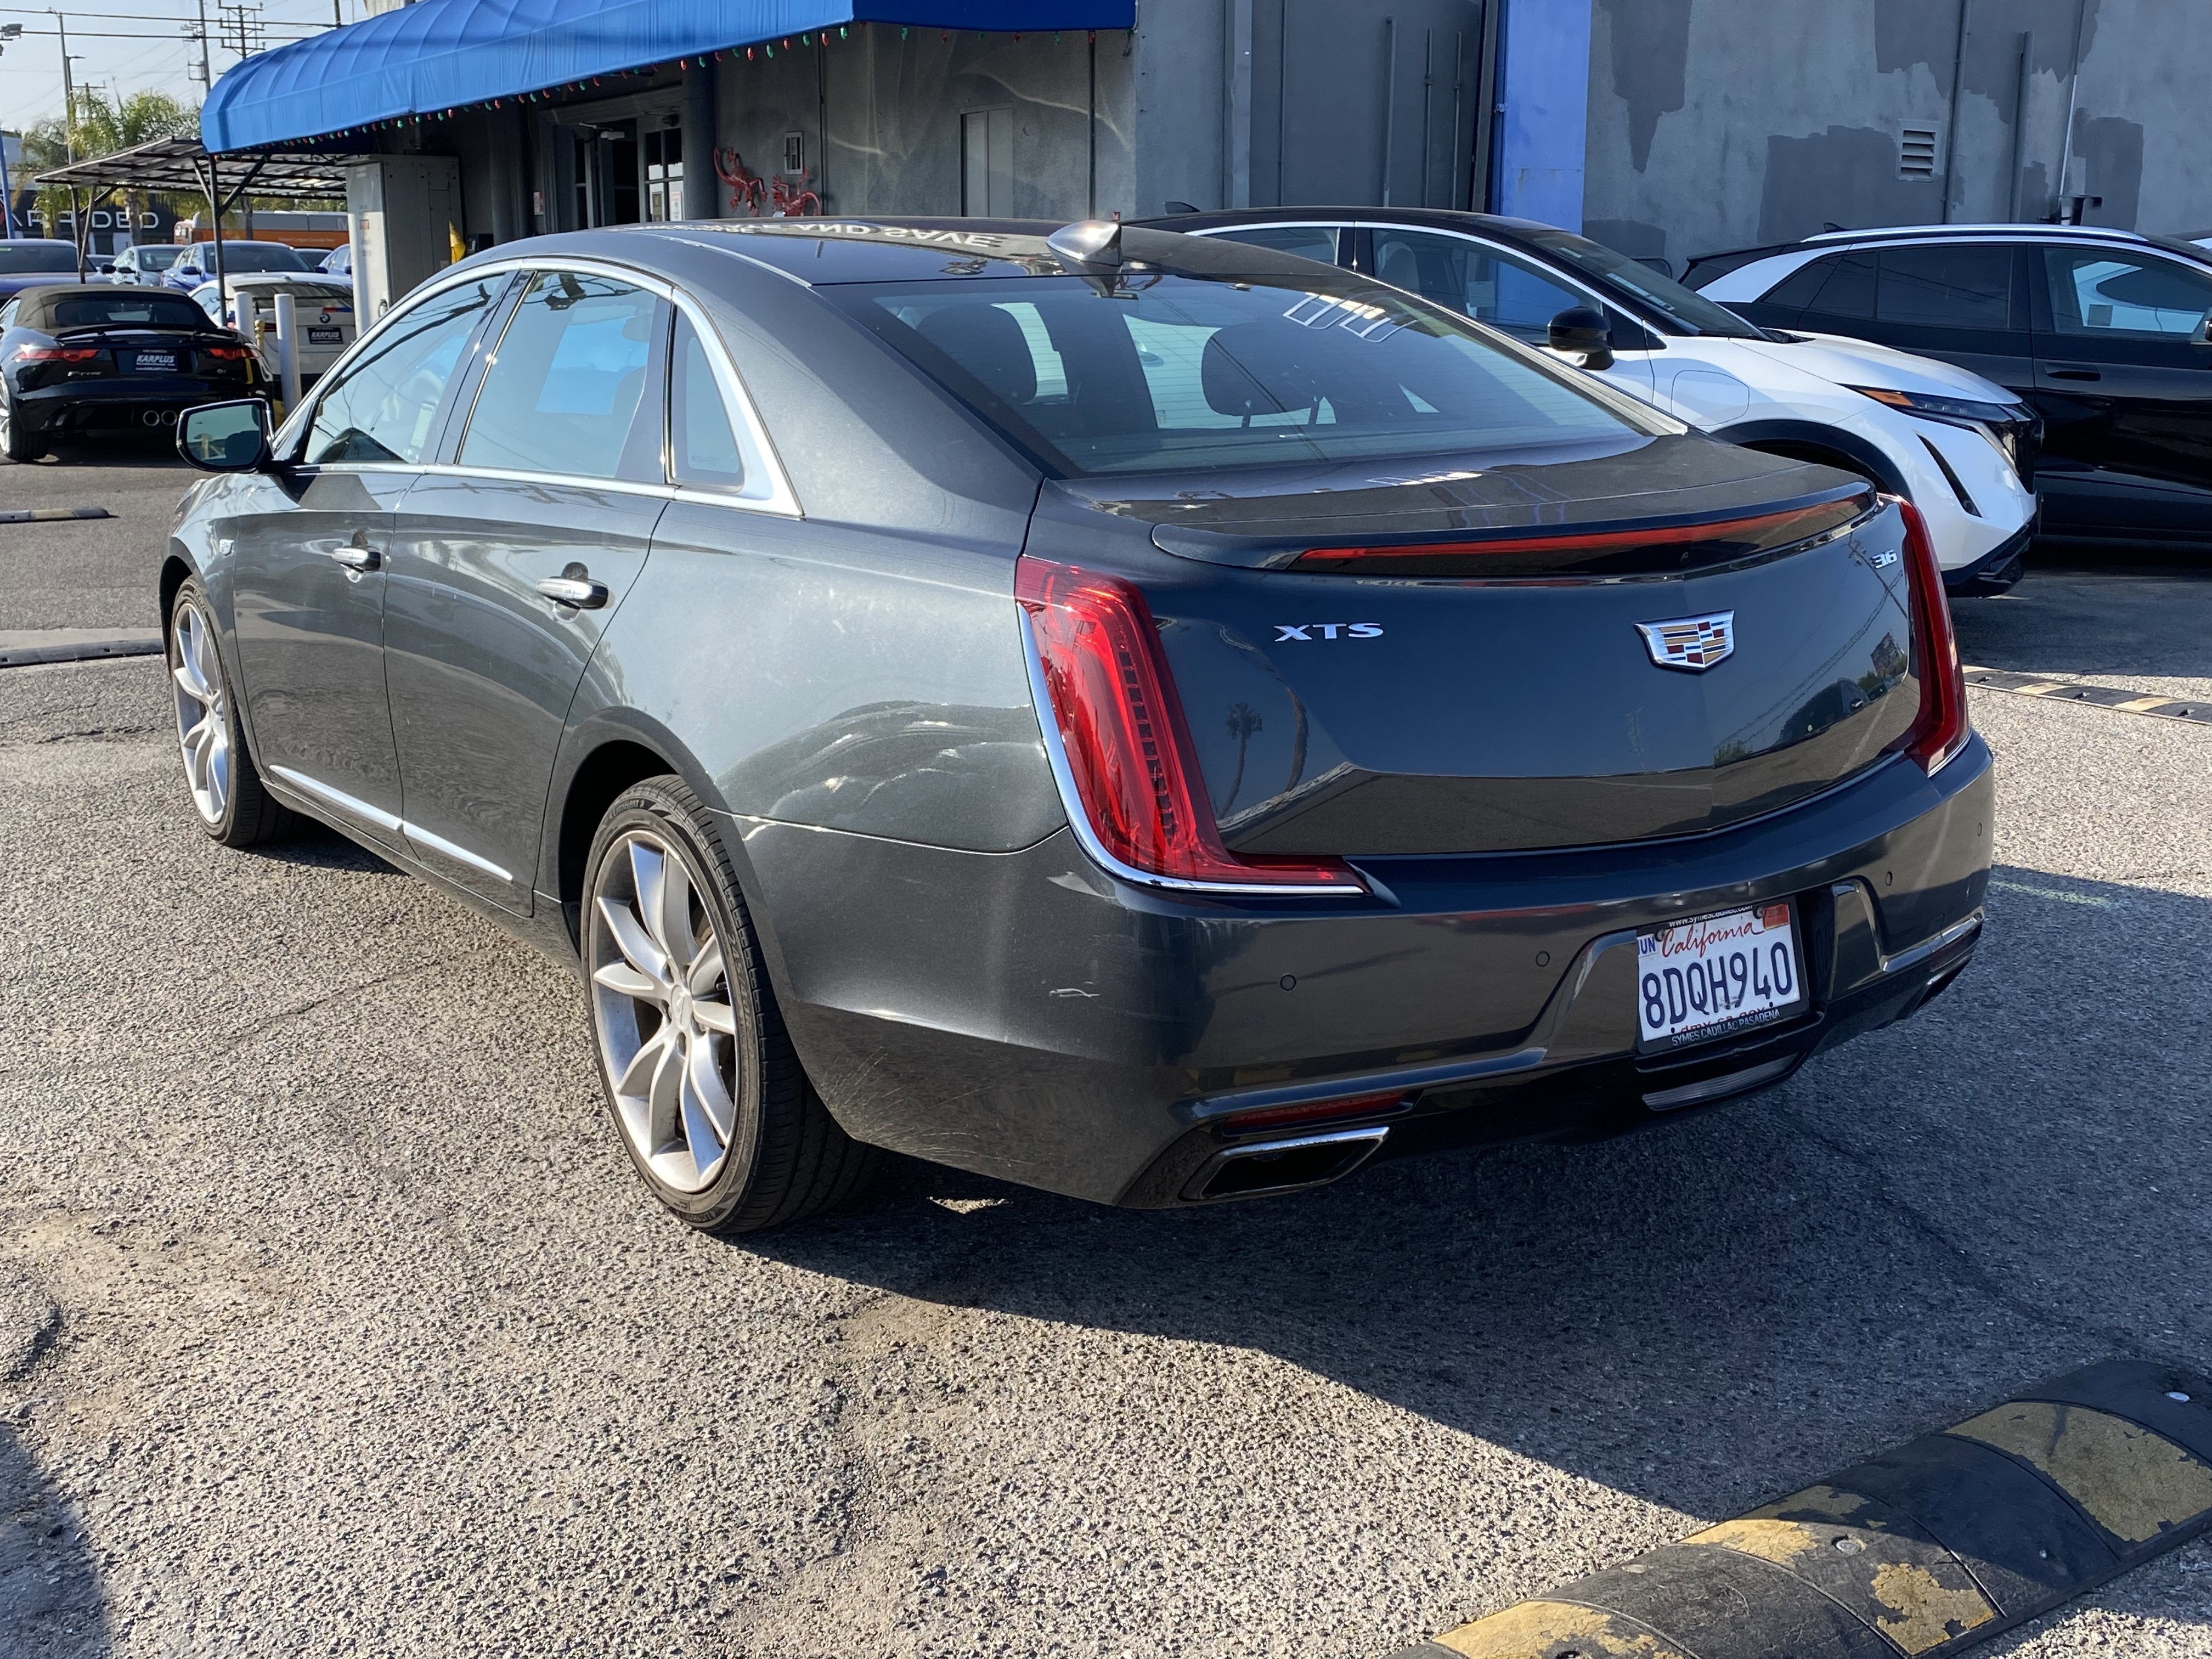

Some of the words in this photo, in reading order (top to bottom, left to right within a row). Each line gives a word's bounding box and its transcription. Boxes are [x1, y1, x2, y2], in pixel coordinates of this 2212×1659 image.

[136, 354, 175, 363] KARPLUS
[1273, 623, 1384, 642] XTS
[1638, 936, 1656, 955] UN
[1661, 921, 1764, 958] California
[1641, 941, 1792, 1029] 8DQH940
[1672, 1031, 1700, 1047] SYMES
[1701, 1021, 1738, 1038] CADILLAC
[1739, 1008, 1780, 1026] PASADENA
